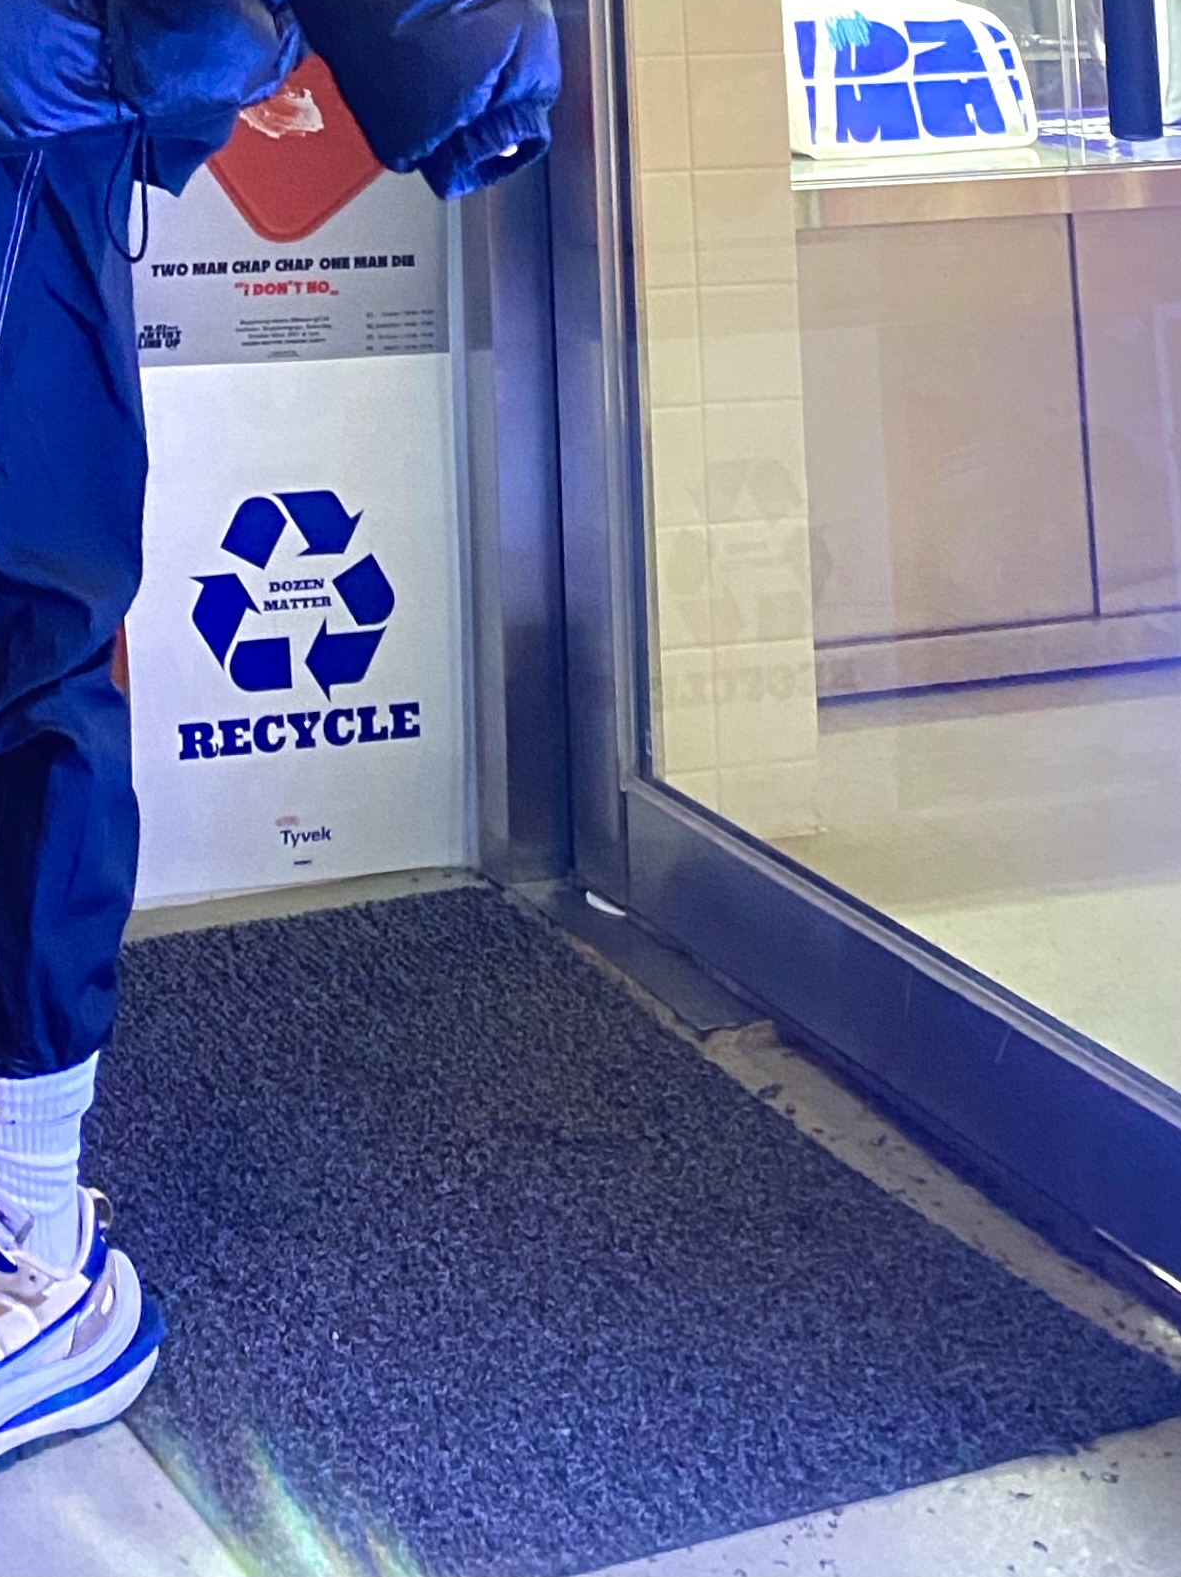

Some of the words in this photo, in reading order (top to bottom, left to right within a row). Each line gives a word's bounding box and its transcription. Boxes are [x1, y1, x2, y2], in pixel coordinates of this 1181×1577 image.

[151, 262, 189, 278] TWO
[192, 261, 228, 276] MAN
[232, 259, 271, 274] CHAP
[275, 258, 314, 273] CHAP
[319, 256, 350, 271] ONE
[354, 255, 388, 270] MAN
[392, 254, 416, 268] DIE
[269, 579, 326, 593] DOZEN
[263, 596, 333, 611] MATTER
[178, 702, 421, 761] RECYCLE
[280, 826, 332, 848] Tyvek
